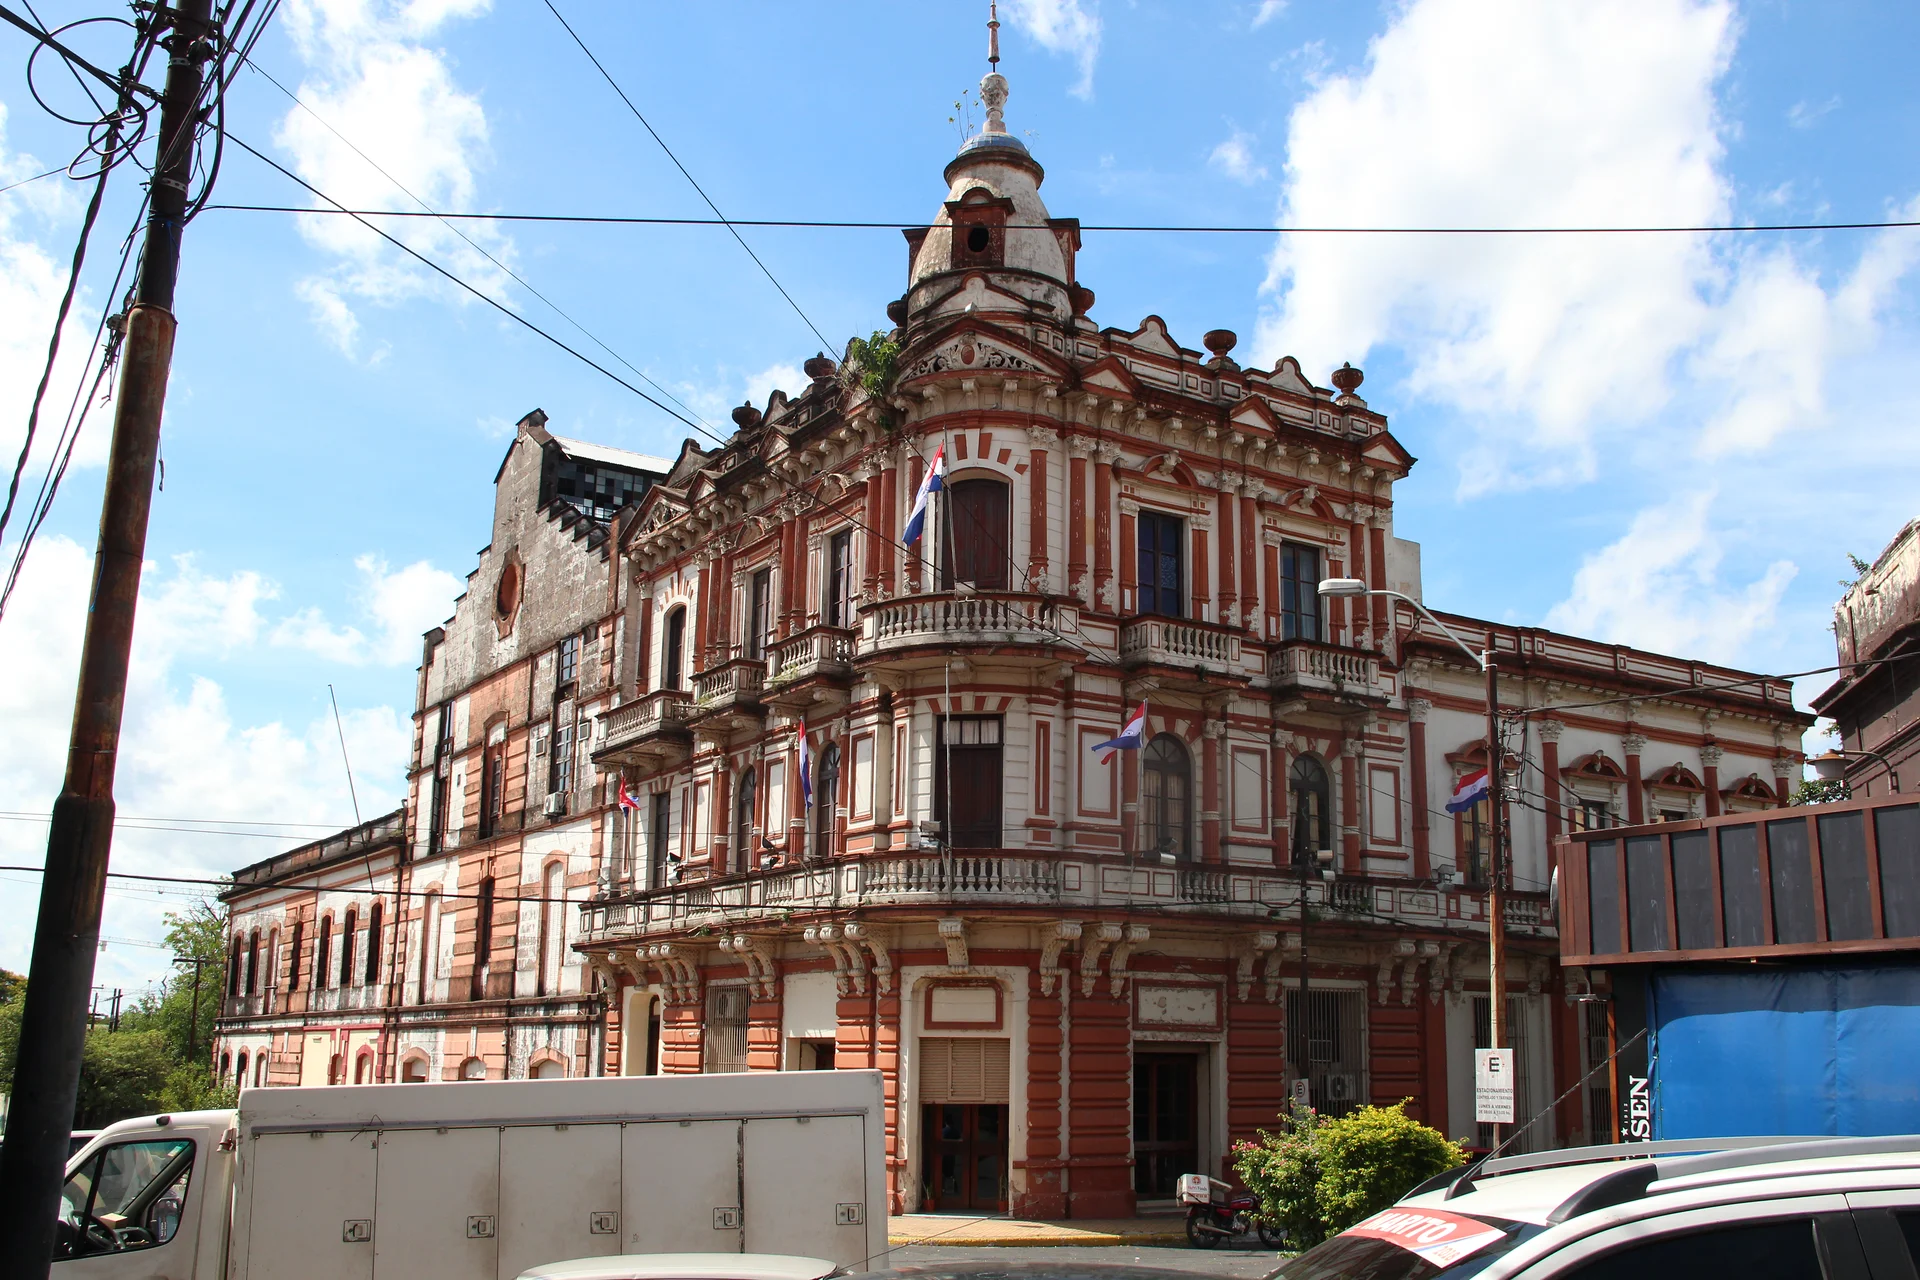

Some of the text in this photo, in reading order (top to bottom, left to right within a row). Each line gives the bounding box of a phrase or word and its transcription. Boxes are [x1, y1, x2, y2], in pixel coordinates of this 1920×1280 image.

[1489, 1057, 1499, 1072] E
[1298, 1084, 1303, 1095] E
[1629, 1075, 1651, 1142] SEN
[1361, 1213, 1457, 1243] MARITO
